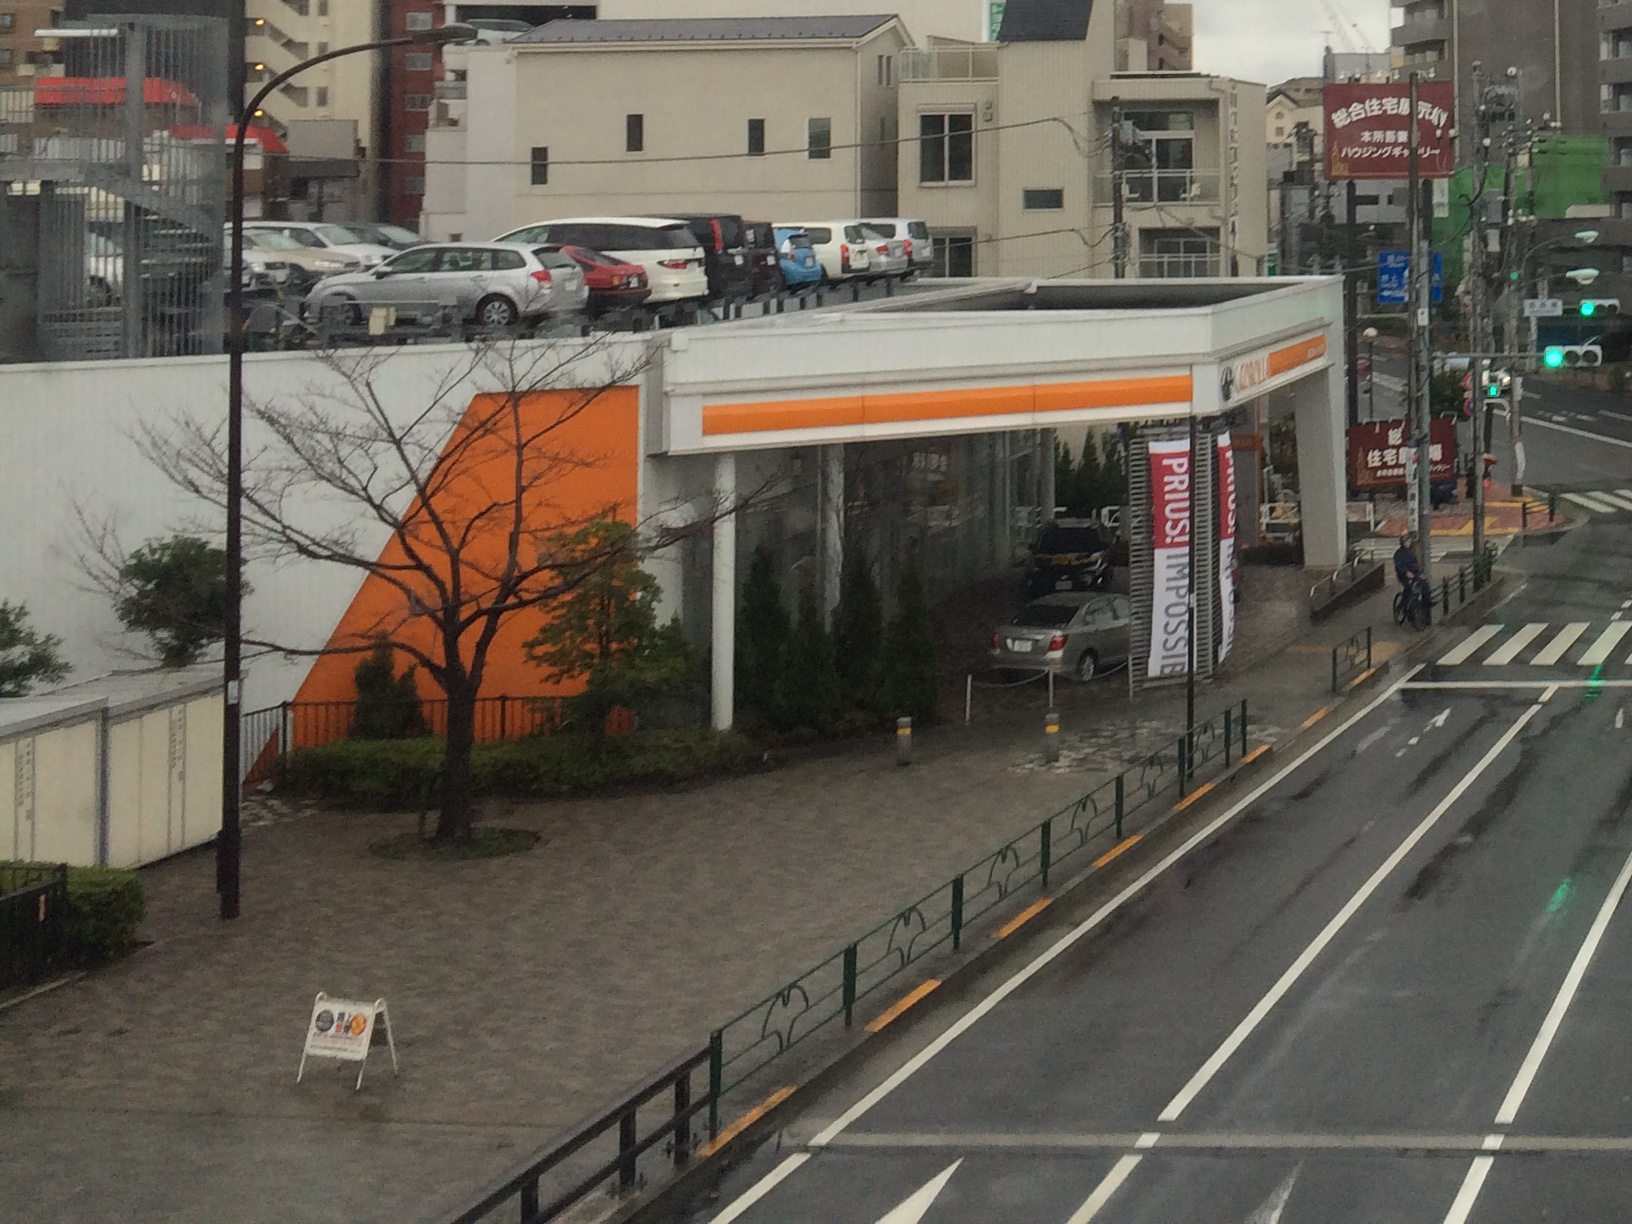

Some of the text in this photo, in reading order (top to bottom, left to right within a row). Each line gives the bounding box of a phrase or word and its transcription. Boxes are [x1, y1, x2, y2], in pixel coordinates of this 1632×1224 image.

[1361, 130, 1420, 144] 本所吾妻
[1162, 457, 1190, 544] PRIUS!
